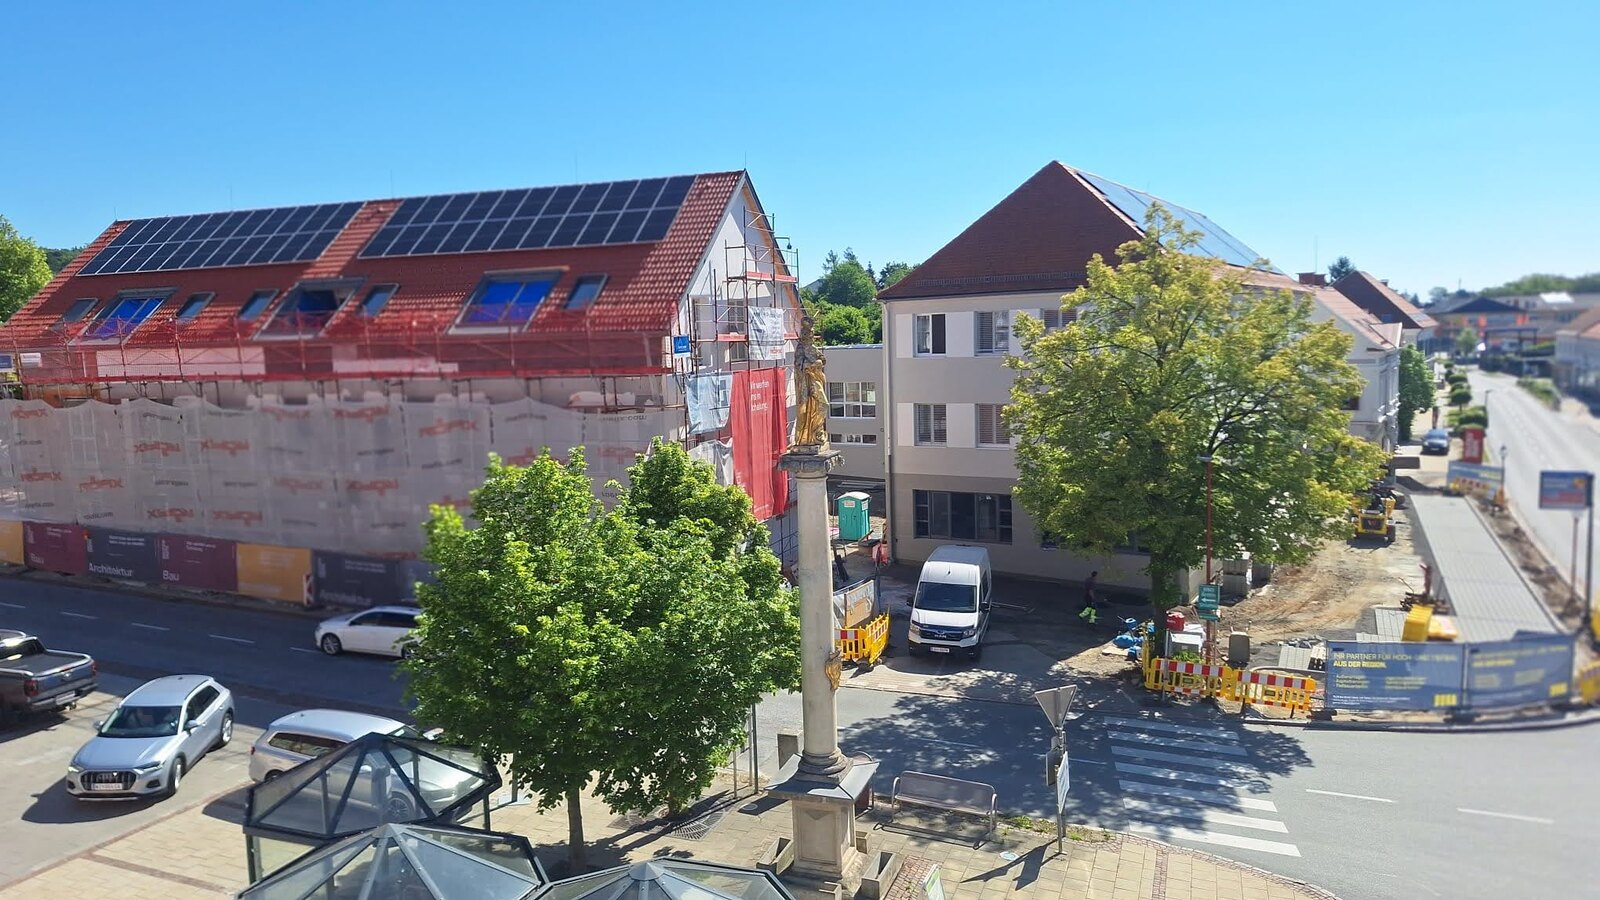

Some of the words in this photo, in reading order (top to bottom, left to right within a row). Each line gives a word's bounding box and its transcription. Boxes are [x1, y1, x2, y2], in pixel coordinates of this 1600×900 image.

[88, 562, 132, 577] Architektur
[163, 569, 180, 582] Bau
[1347, 660, 1361, 668] DER
